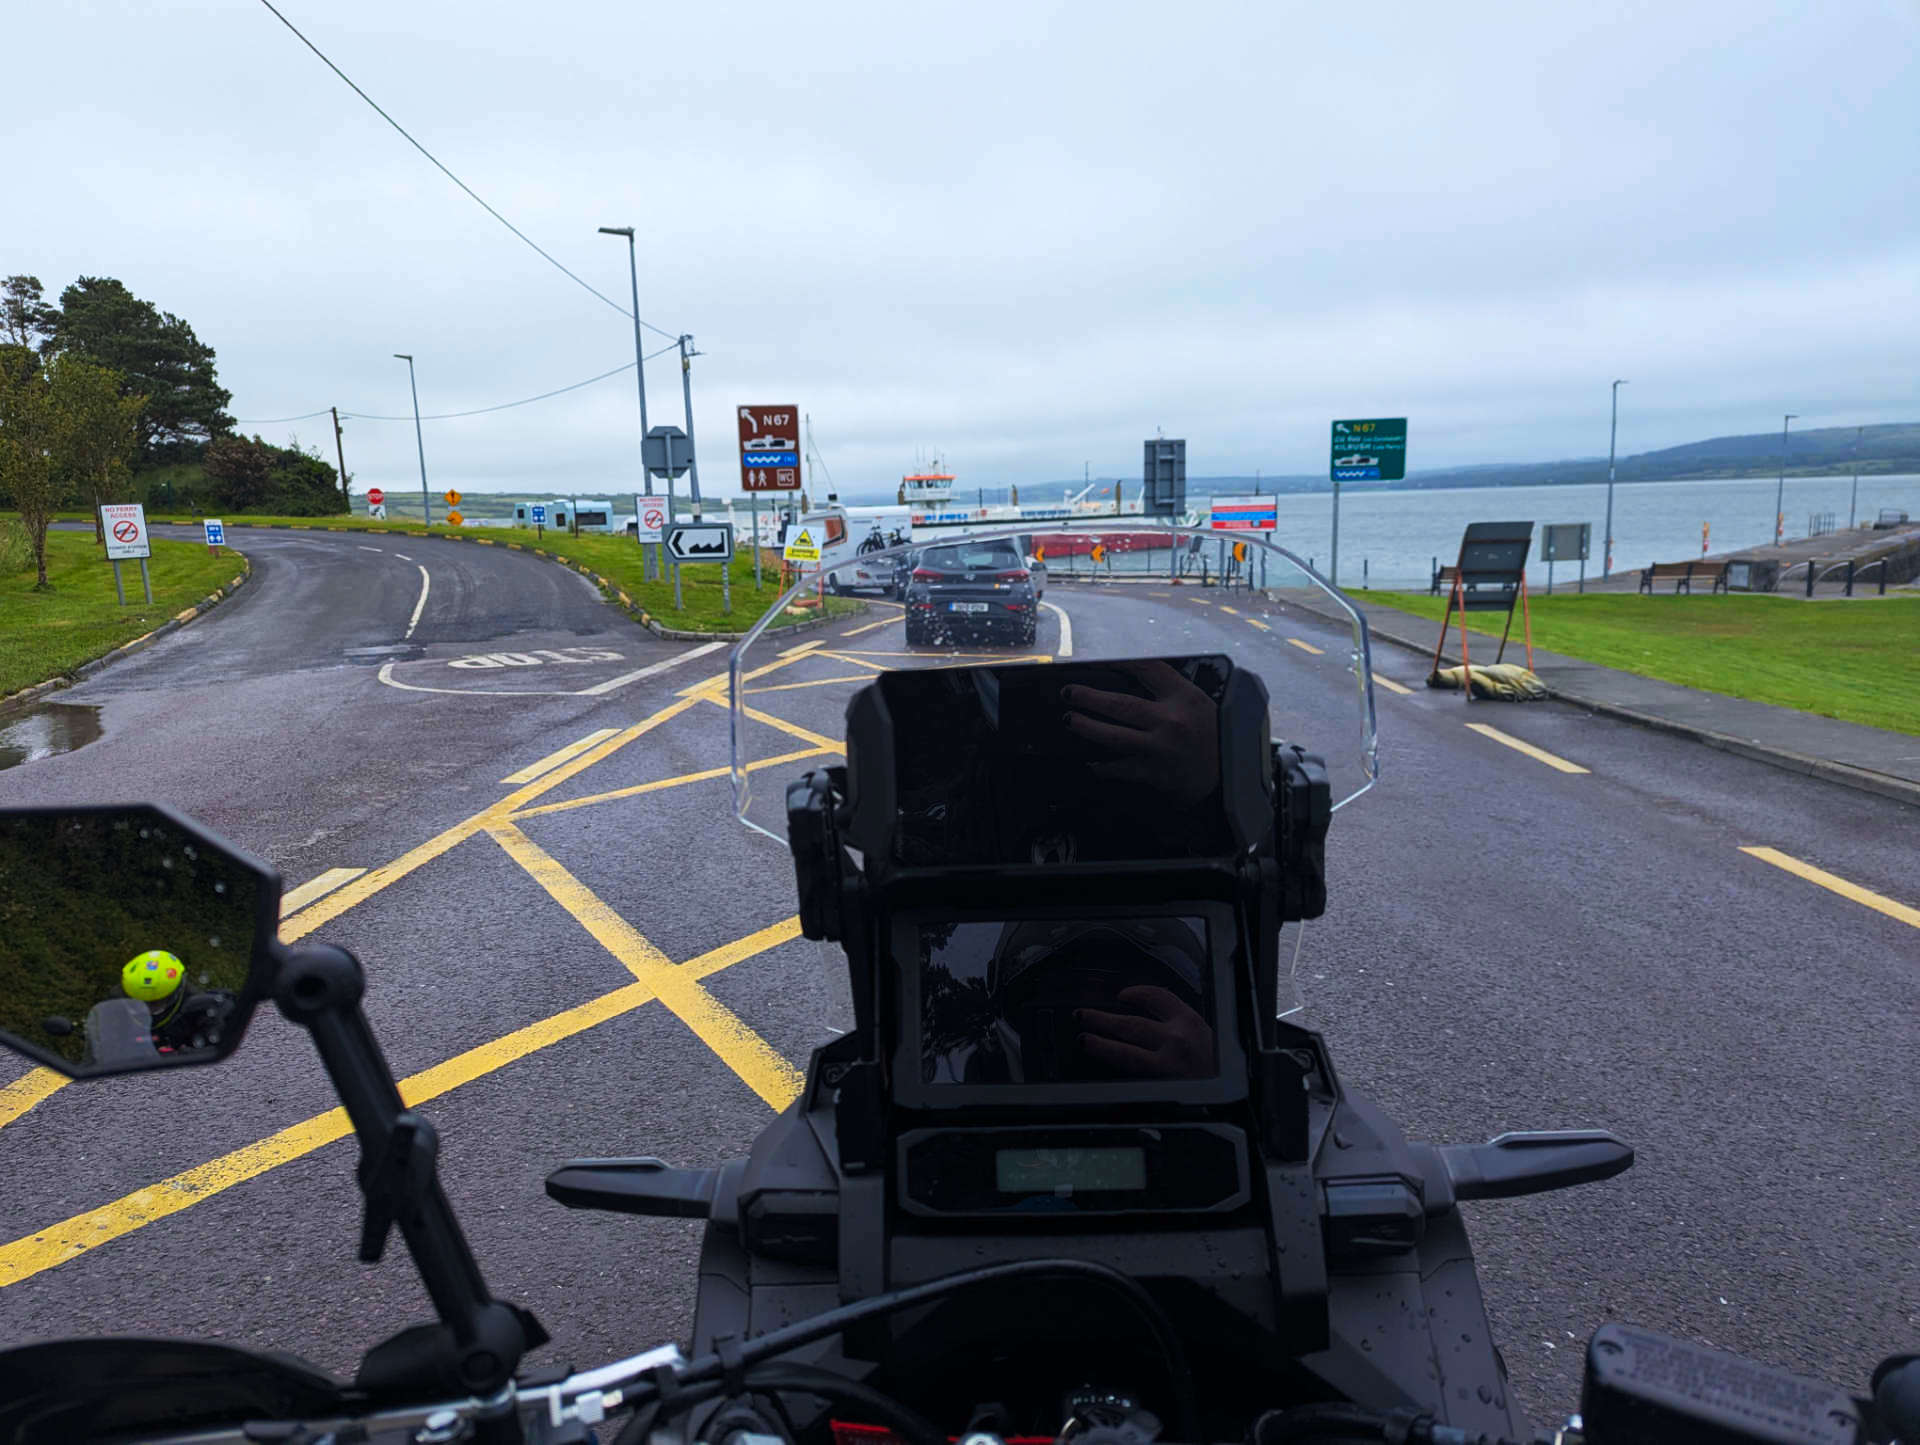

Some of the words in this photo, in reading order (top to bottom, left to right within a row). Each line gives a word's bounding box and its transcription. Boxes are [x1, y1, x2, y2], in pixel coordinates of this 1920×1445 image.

[763, 414, 790, 426] N67
[1353, 423, 1376, 433] N67
[779, 472, 793, 482] WC
[447, 647, 626, 669] STOP
